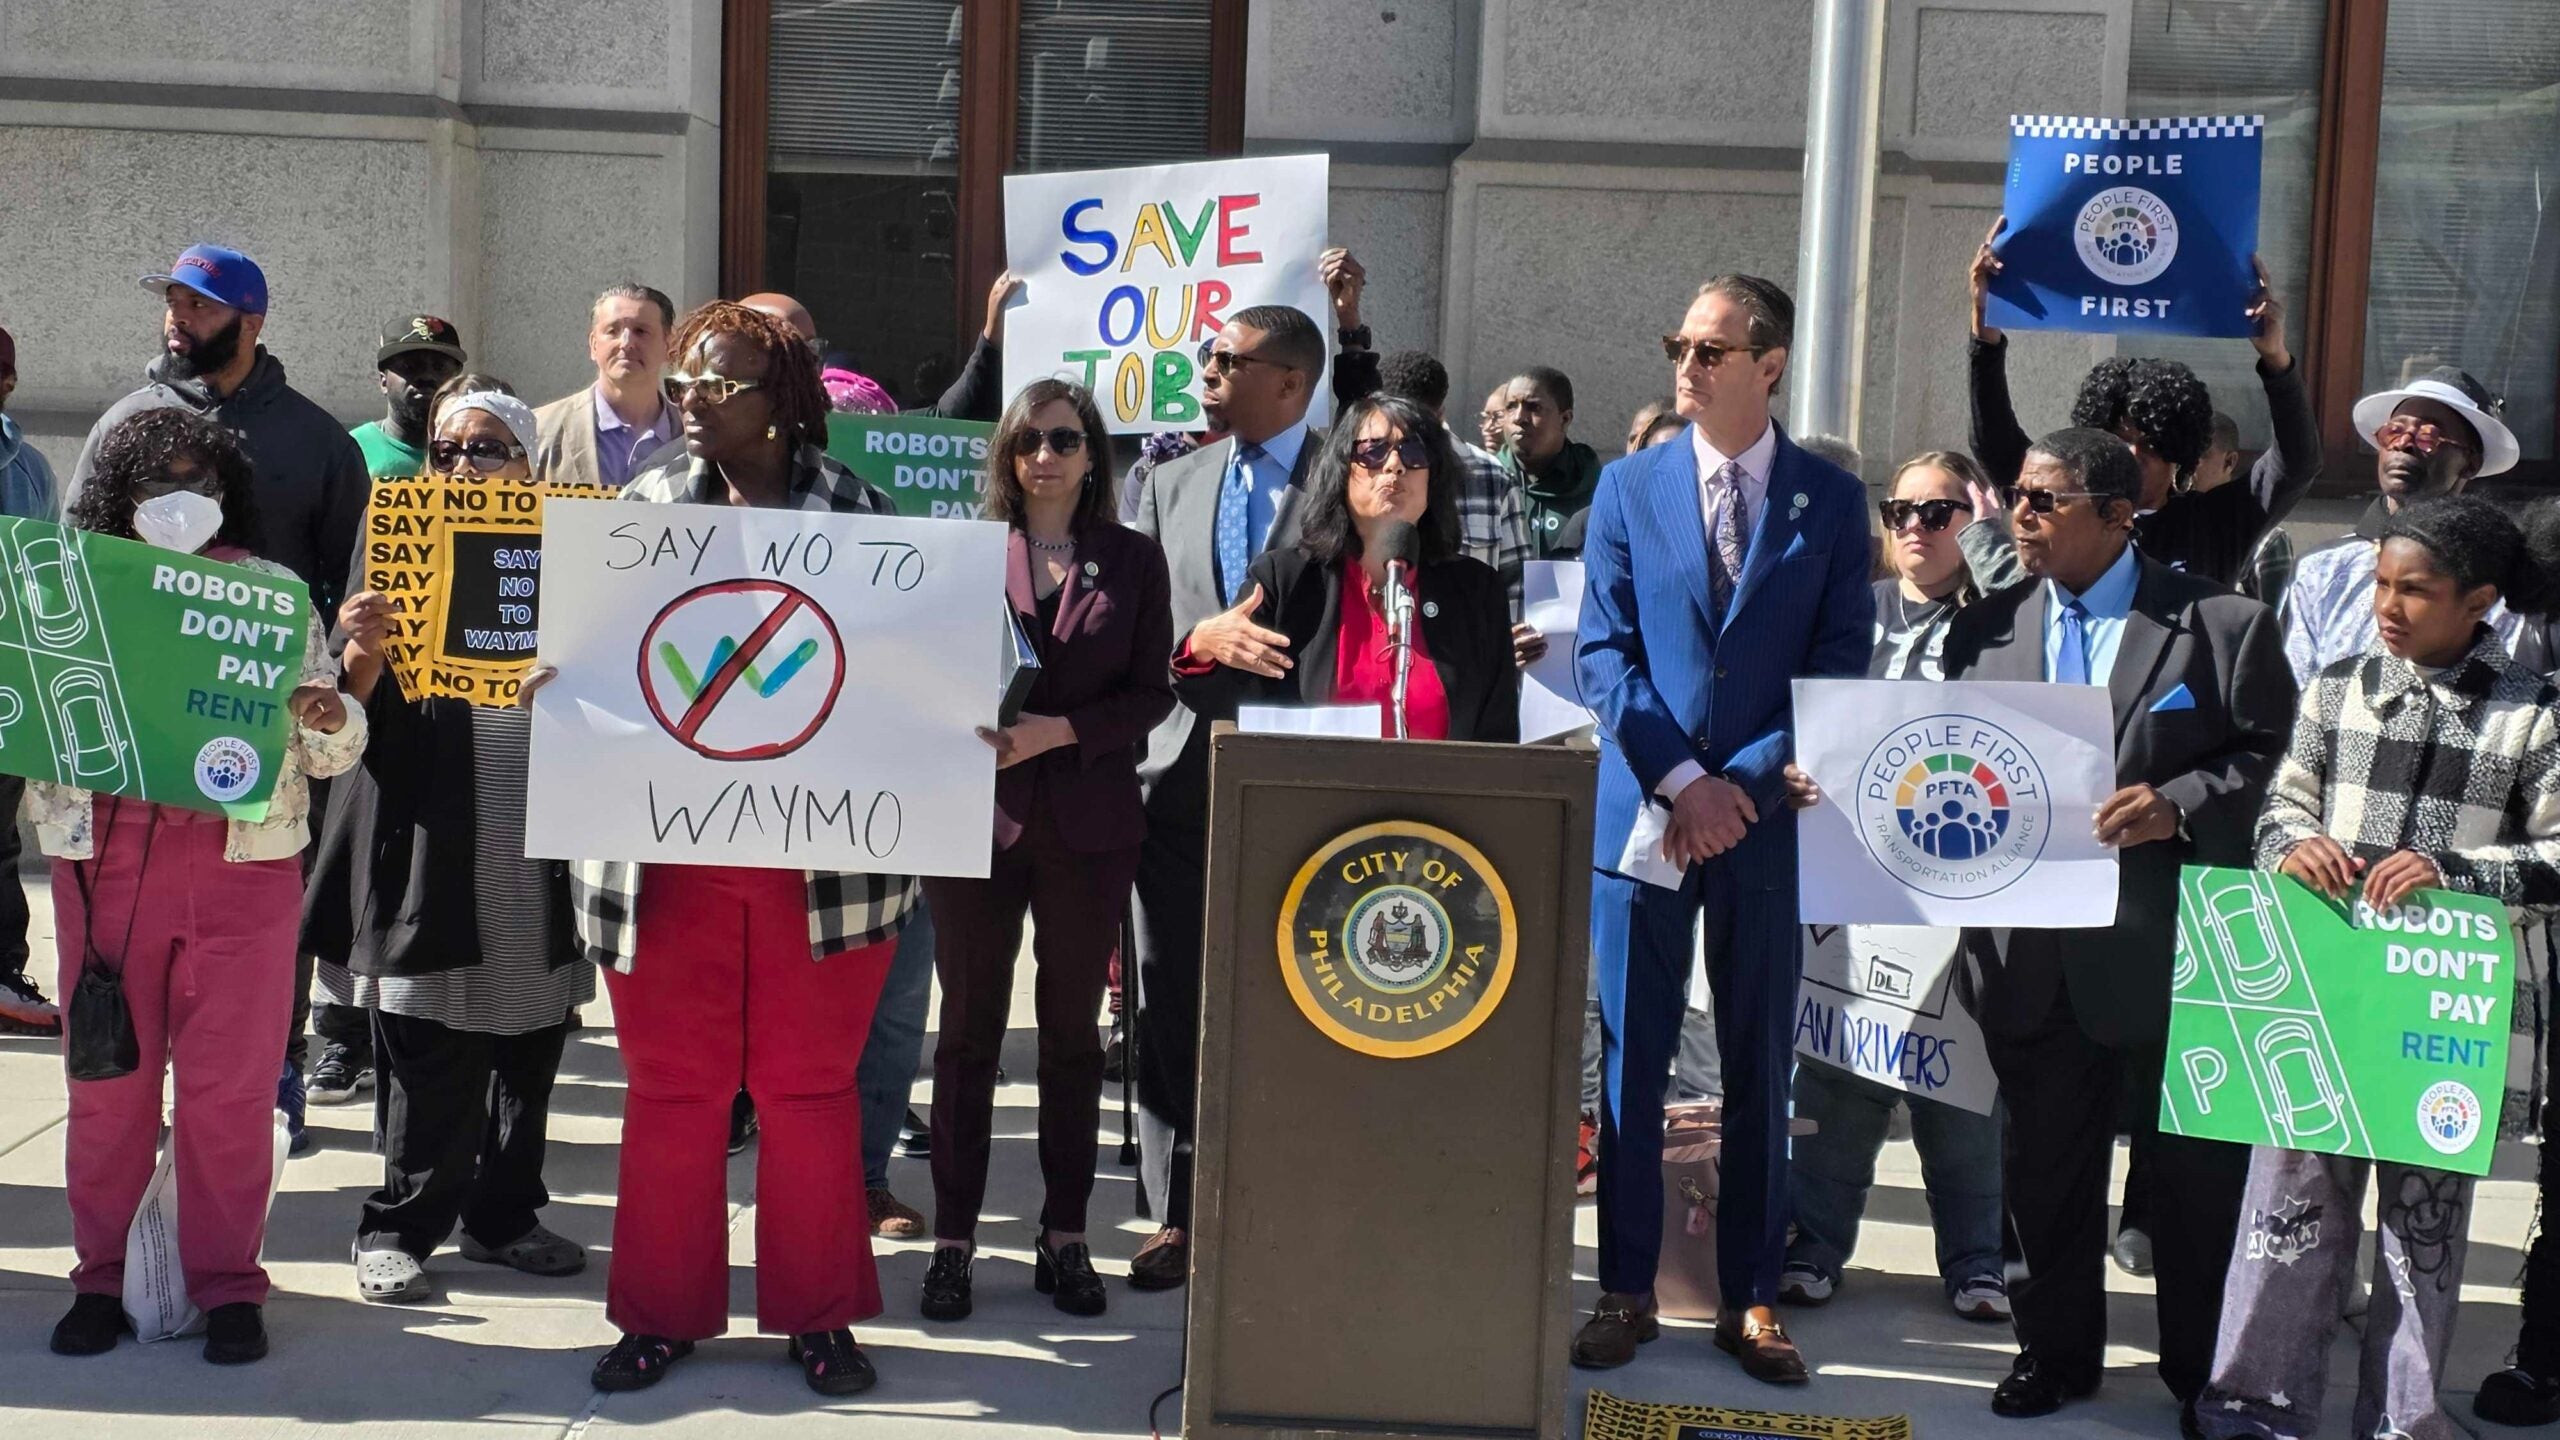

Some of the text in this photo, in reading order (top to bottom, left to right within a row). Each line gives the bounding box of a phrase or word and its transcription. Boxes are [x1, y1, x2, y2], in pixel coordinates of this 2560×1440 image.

[2064, 153, 2182, 175] PEOPLE
[2080, 191, 2173, 233] PEOPLE FIRST
[2112, 221, 2140, 232] PFTA
[1060, 193, 1263, 276] SAVE
[1099, 280, 1232, 349] OUR
[2081, 296, 2171, 318] FIRST
[865, 430, 988, 460] ROBOTS
[894, 465, 987, 493] DON'T
[374, 488, 537, 512] SAY NO TO
[931, 500, 984, 520] PAY
[372, 514, 435, 536] SAY
[371, 542, 435, 564] SAY
[494, 549, 542, 570] SAY
[606, 522, 925, 591] SAY NO TO
[152, 564, 295, 616] ROBOTS
[370, 570, 434, 591] SAY
[499, 577, 535, 597] NO
[499, 604, 532, 624] TO
[180, 608, 294, 653] DON'T
[465, 629, 540, 651] WAYM
[217, 654, 286, 691] PAY
[430, 670, 475, 693] NO
[484, 679, 521, 699] TO
[186, 688, 279, 728] RENT
[200, 740, 258, 771] PEOPLE FIRST
[1868, 725, 2038, 801] PEOPLE FIRST
[1926, 780, 1978, 799] PFTA
[649, 780, 901, 859] WAYMO
[1873, 813, 2035, 884] TRANSPORTATION ALLIANCE
[1342, 851, 1463, 890] CITY OF
[2352, 900, 2498, 941] ROBOTS
[1309, 930, 1485, 1024] PHILADELPHIA
[2386, 944, 2500, 984] DON'T
[1875, 970, 1900, 993] DL
[2430, 990, 2496, 1026] PAY
[1840, 1009, 1957, 1091] DRIVERS
[2402, 1031, 2492, 1068] RENT
[2421, 1084, 2478, 1117] PEOPLE FIRST
[1732, 1417, 1778, 1430] TO
[1786, 1422, 1834, 1434] NO
